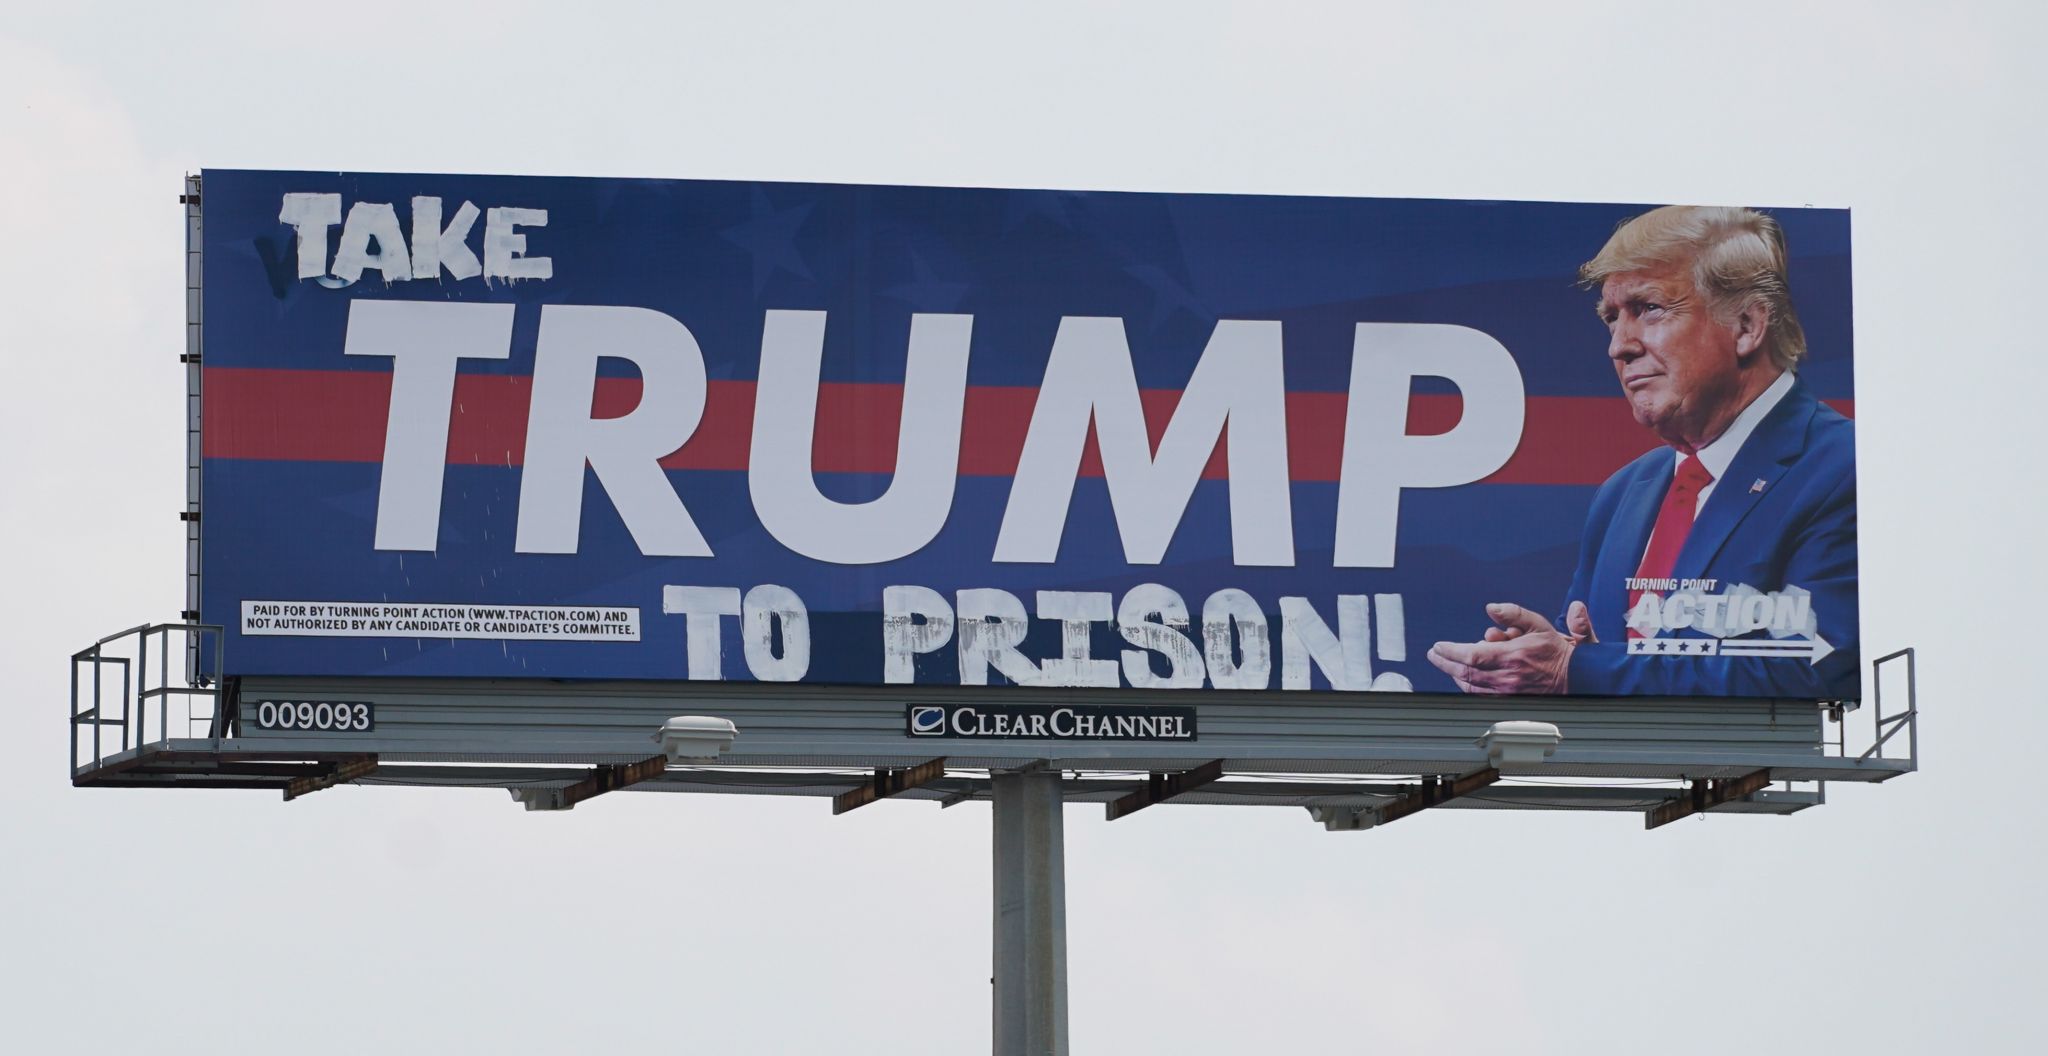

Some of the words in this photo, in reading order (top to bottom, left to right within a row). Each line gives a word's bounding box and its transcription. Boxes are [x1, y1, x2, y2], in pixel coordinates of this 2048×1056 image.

[279, 192, 553, 284] TAKE
[344, 299, 1527, 569] TRUMP
[1625, 577, 1678, 591] TURNING
[1680, 578, 1718, 592] POINT
[247, 618, 271, 629] NOT
[274, 618, 348, 630] AUTHORIZED
[352, 620, 367, 630] BY
[369, 620, 392, 631] ANY
[396, 620, 461, 632] CANDIDATE
[464, 622, 480, 632] OR
[484, 622, 560, 634] CANDIDATE'S
[563, 623, 635, 635] COMMITTEE.
[253, 605, 280, 616] PAID
[284, 606, 306, 617] FOR
[310, 606, 325, 617] BY
[327, 606, 380, 618] TURNING
[383, 607, 419, 618] POINT
[422, 608, 465, 619] ACTION
[468, 608, 600, 622] (WWW.TPACTION.COM)
[604, 611, 628, 622] AND
[1626, 591, 1812, 632] ACTION
[663, 583, 811, 682] TO
[882, 582, 1414, 692] PRISON!
[258, 701, 369, 730] 009093
